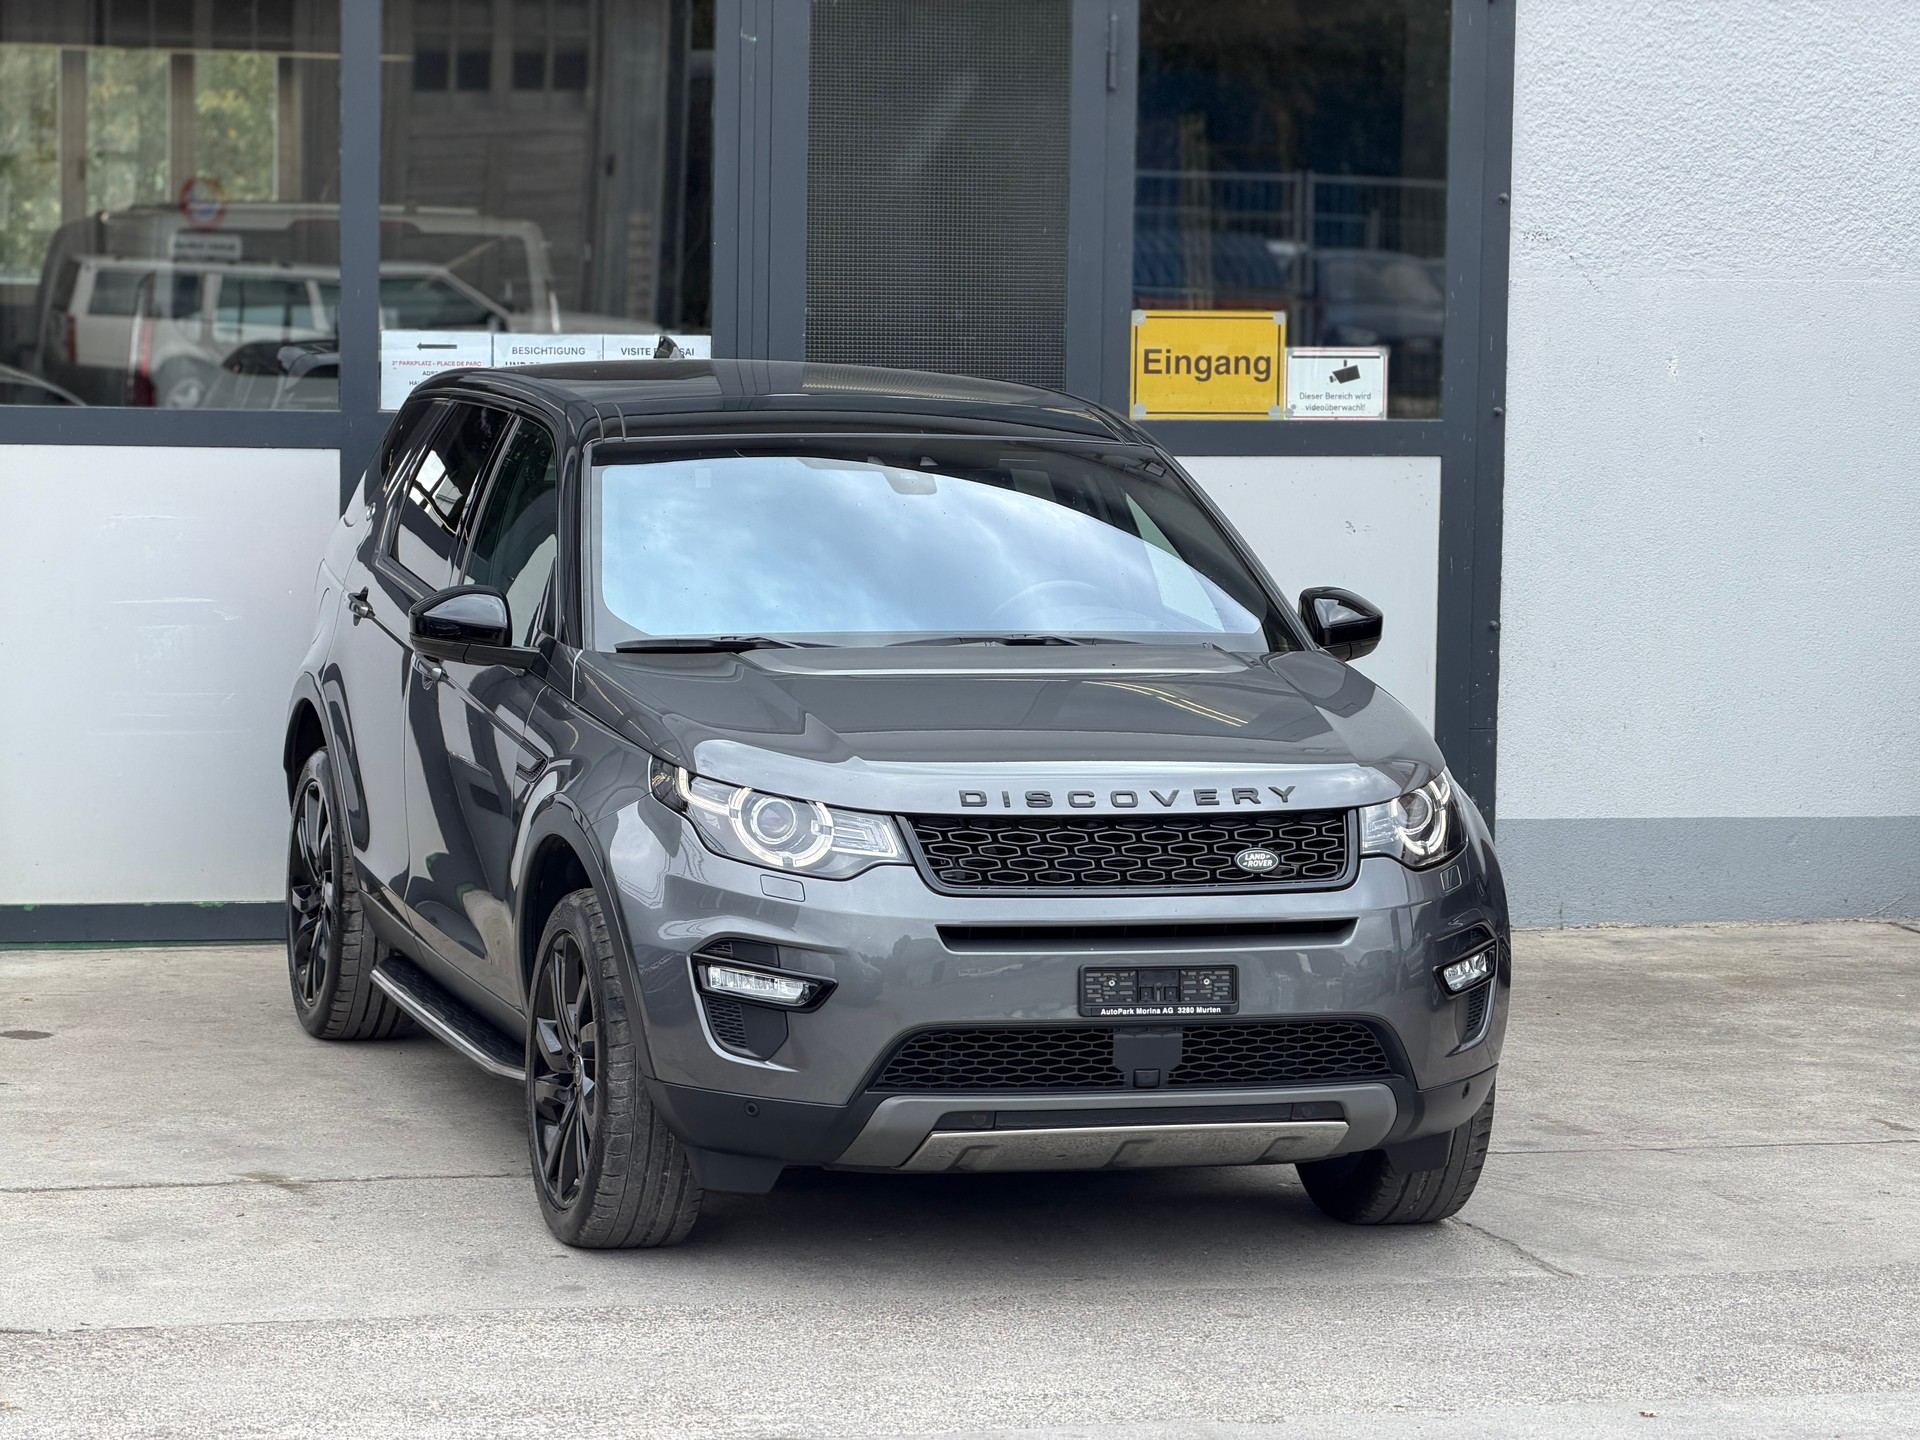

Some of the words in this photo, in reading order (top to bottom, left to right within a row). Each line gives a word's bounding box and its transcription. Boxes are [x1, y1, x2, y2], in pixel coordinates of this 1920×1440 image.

[511, 346, 586, 355] BESICHTIGUNG
[620, 347, 651, 356] VISITE
[1143, 348, 1271, 383] Eingang
[1299, 392, 1323, 400] Dieser
[1325, 392, 1353, 400] Bereich
[1355, 392, 1372, 400] wird
[1305, 403, 1366, 411] videoüberwacht!
[959, 785, 1296, 808] DISCOVERY
[1100, 1007, 1134, 1015] AutoPark
[1136, 1007, 1160, 1015] Morina
[1177, 1006, 1194, 1014] 3280
[1196, 1006, 1222, 1014] Murten
